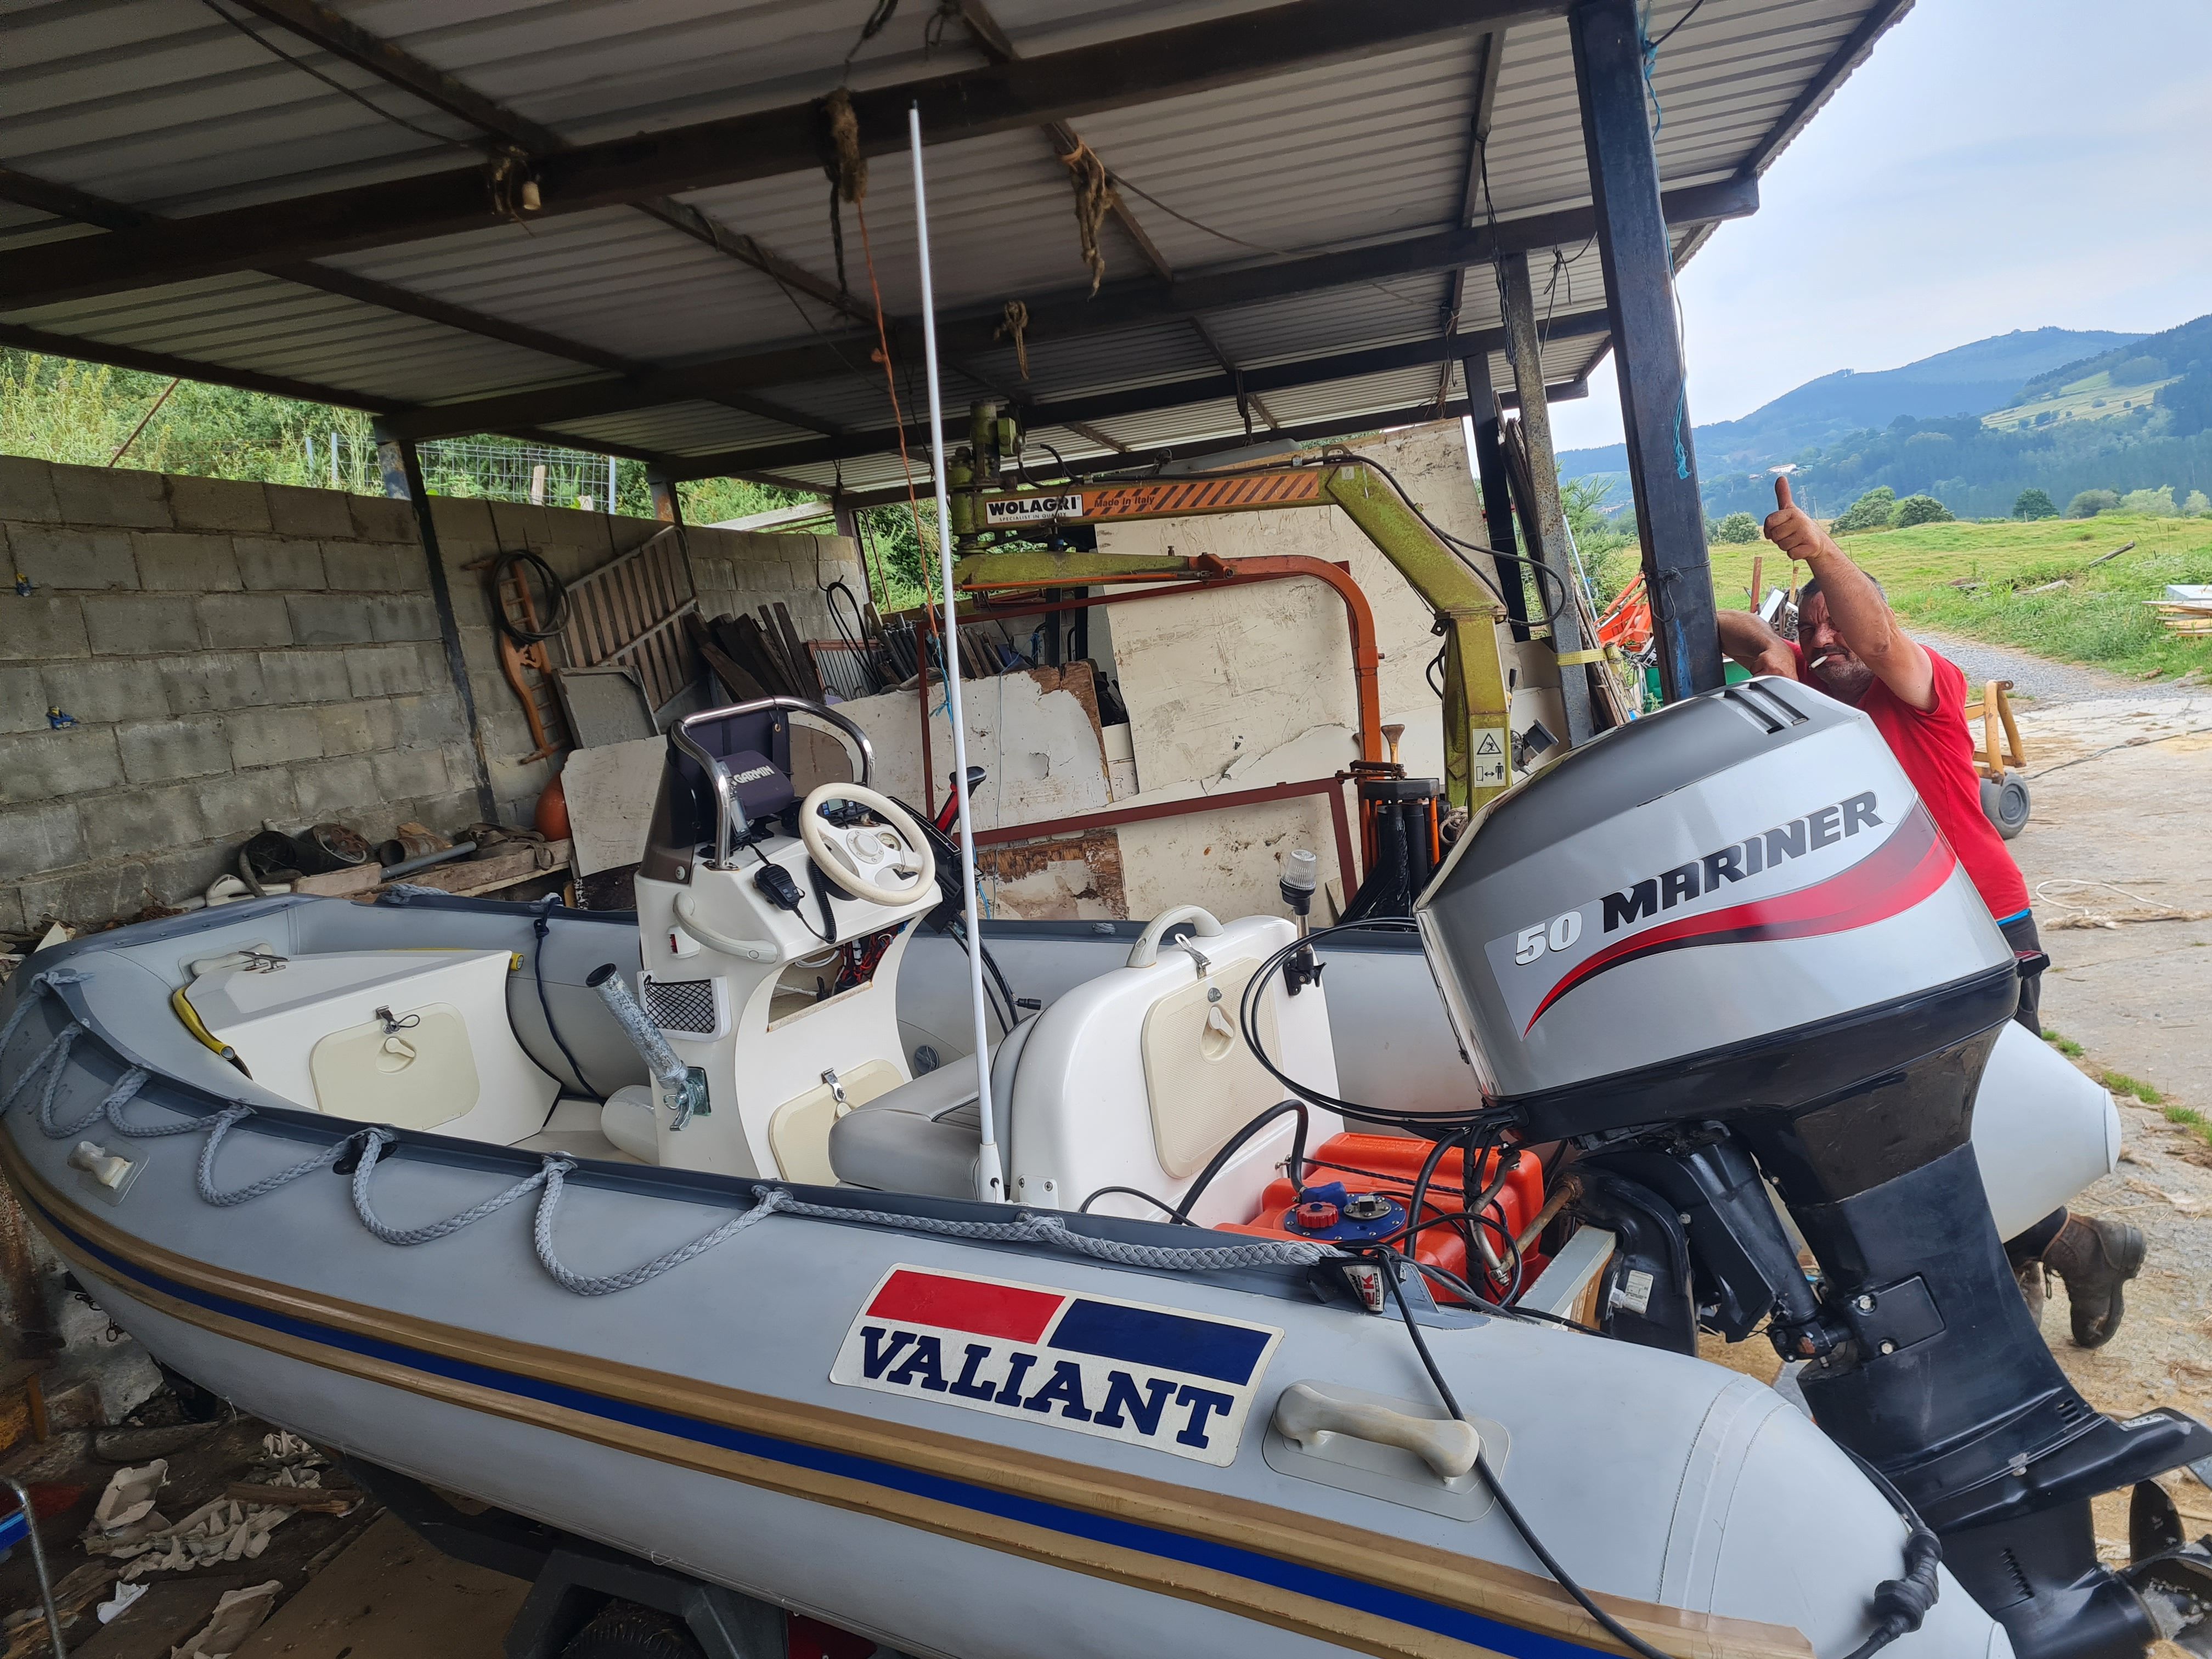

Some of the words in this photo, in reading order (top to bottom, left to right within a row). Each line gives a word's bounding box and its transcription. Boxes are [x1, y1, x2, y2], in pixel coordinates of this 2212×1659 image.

[1094, 499, 1119, 507] Made
[1135, 495, 1155, 505] Italy
[733, 765, 775, 784] GARMIN
[1515, 911, 1582, 966] 50
[1599, 789, 1884, 933] MARINER
[860, 1326, 1234, 1449] VALIANT
